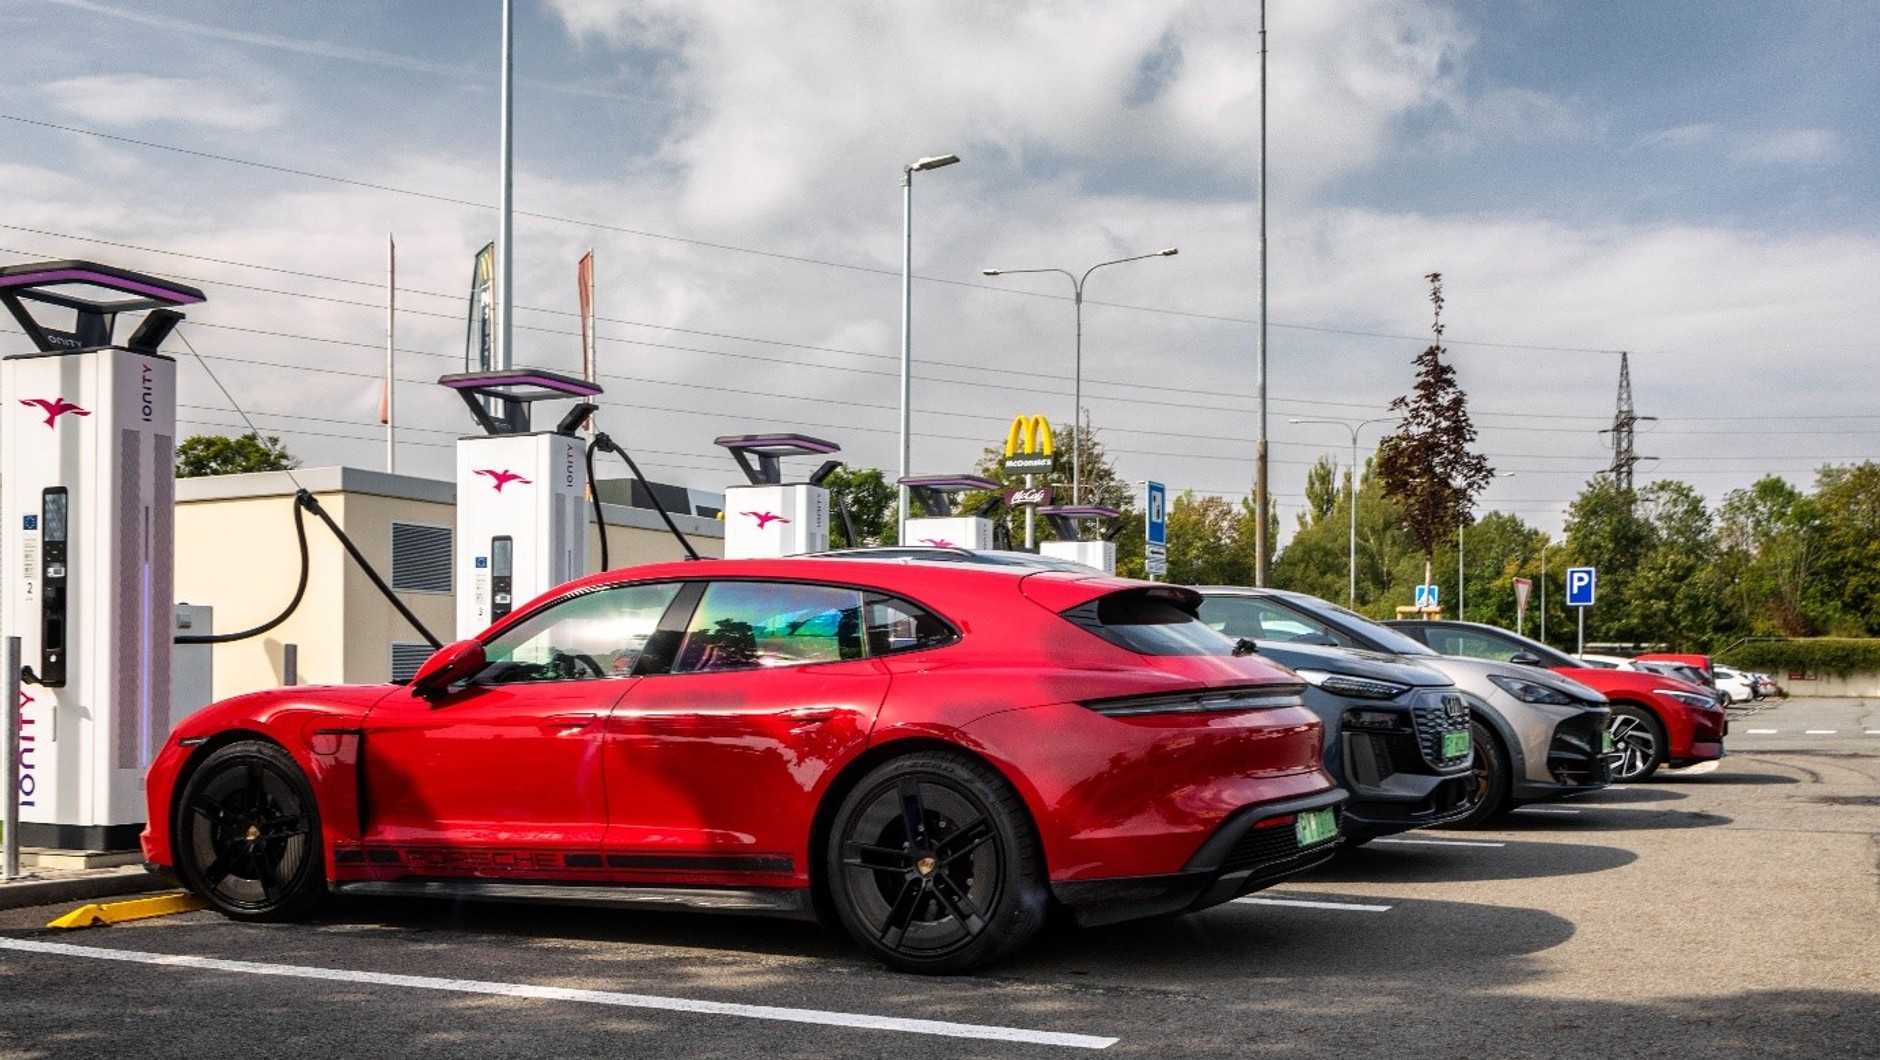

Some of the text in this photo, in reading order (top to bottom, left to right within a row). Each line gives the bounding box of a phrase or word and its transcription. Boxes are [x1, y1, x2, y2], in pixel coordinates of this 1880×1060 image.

[1005, 459, 1052, 468] McDonald's
[27, 582, 33, 594] 2
[1572, 572, 1589, 594] P
[405, 850, 559, 868] PORSCHE
